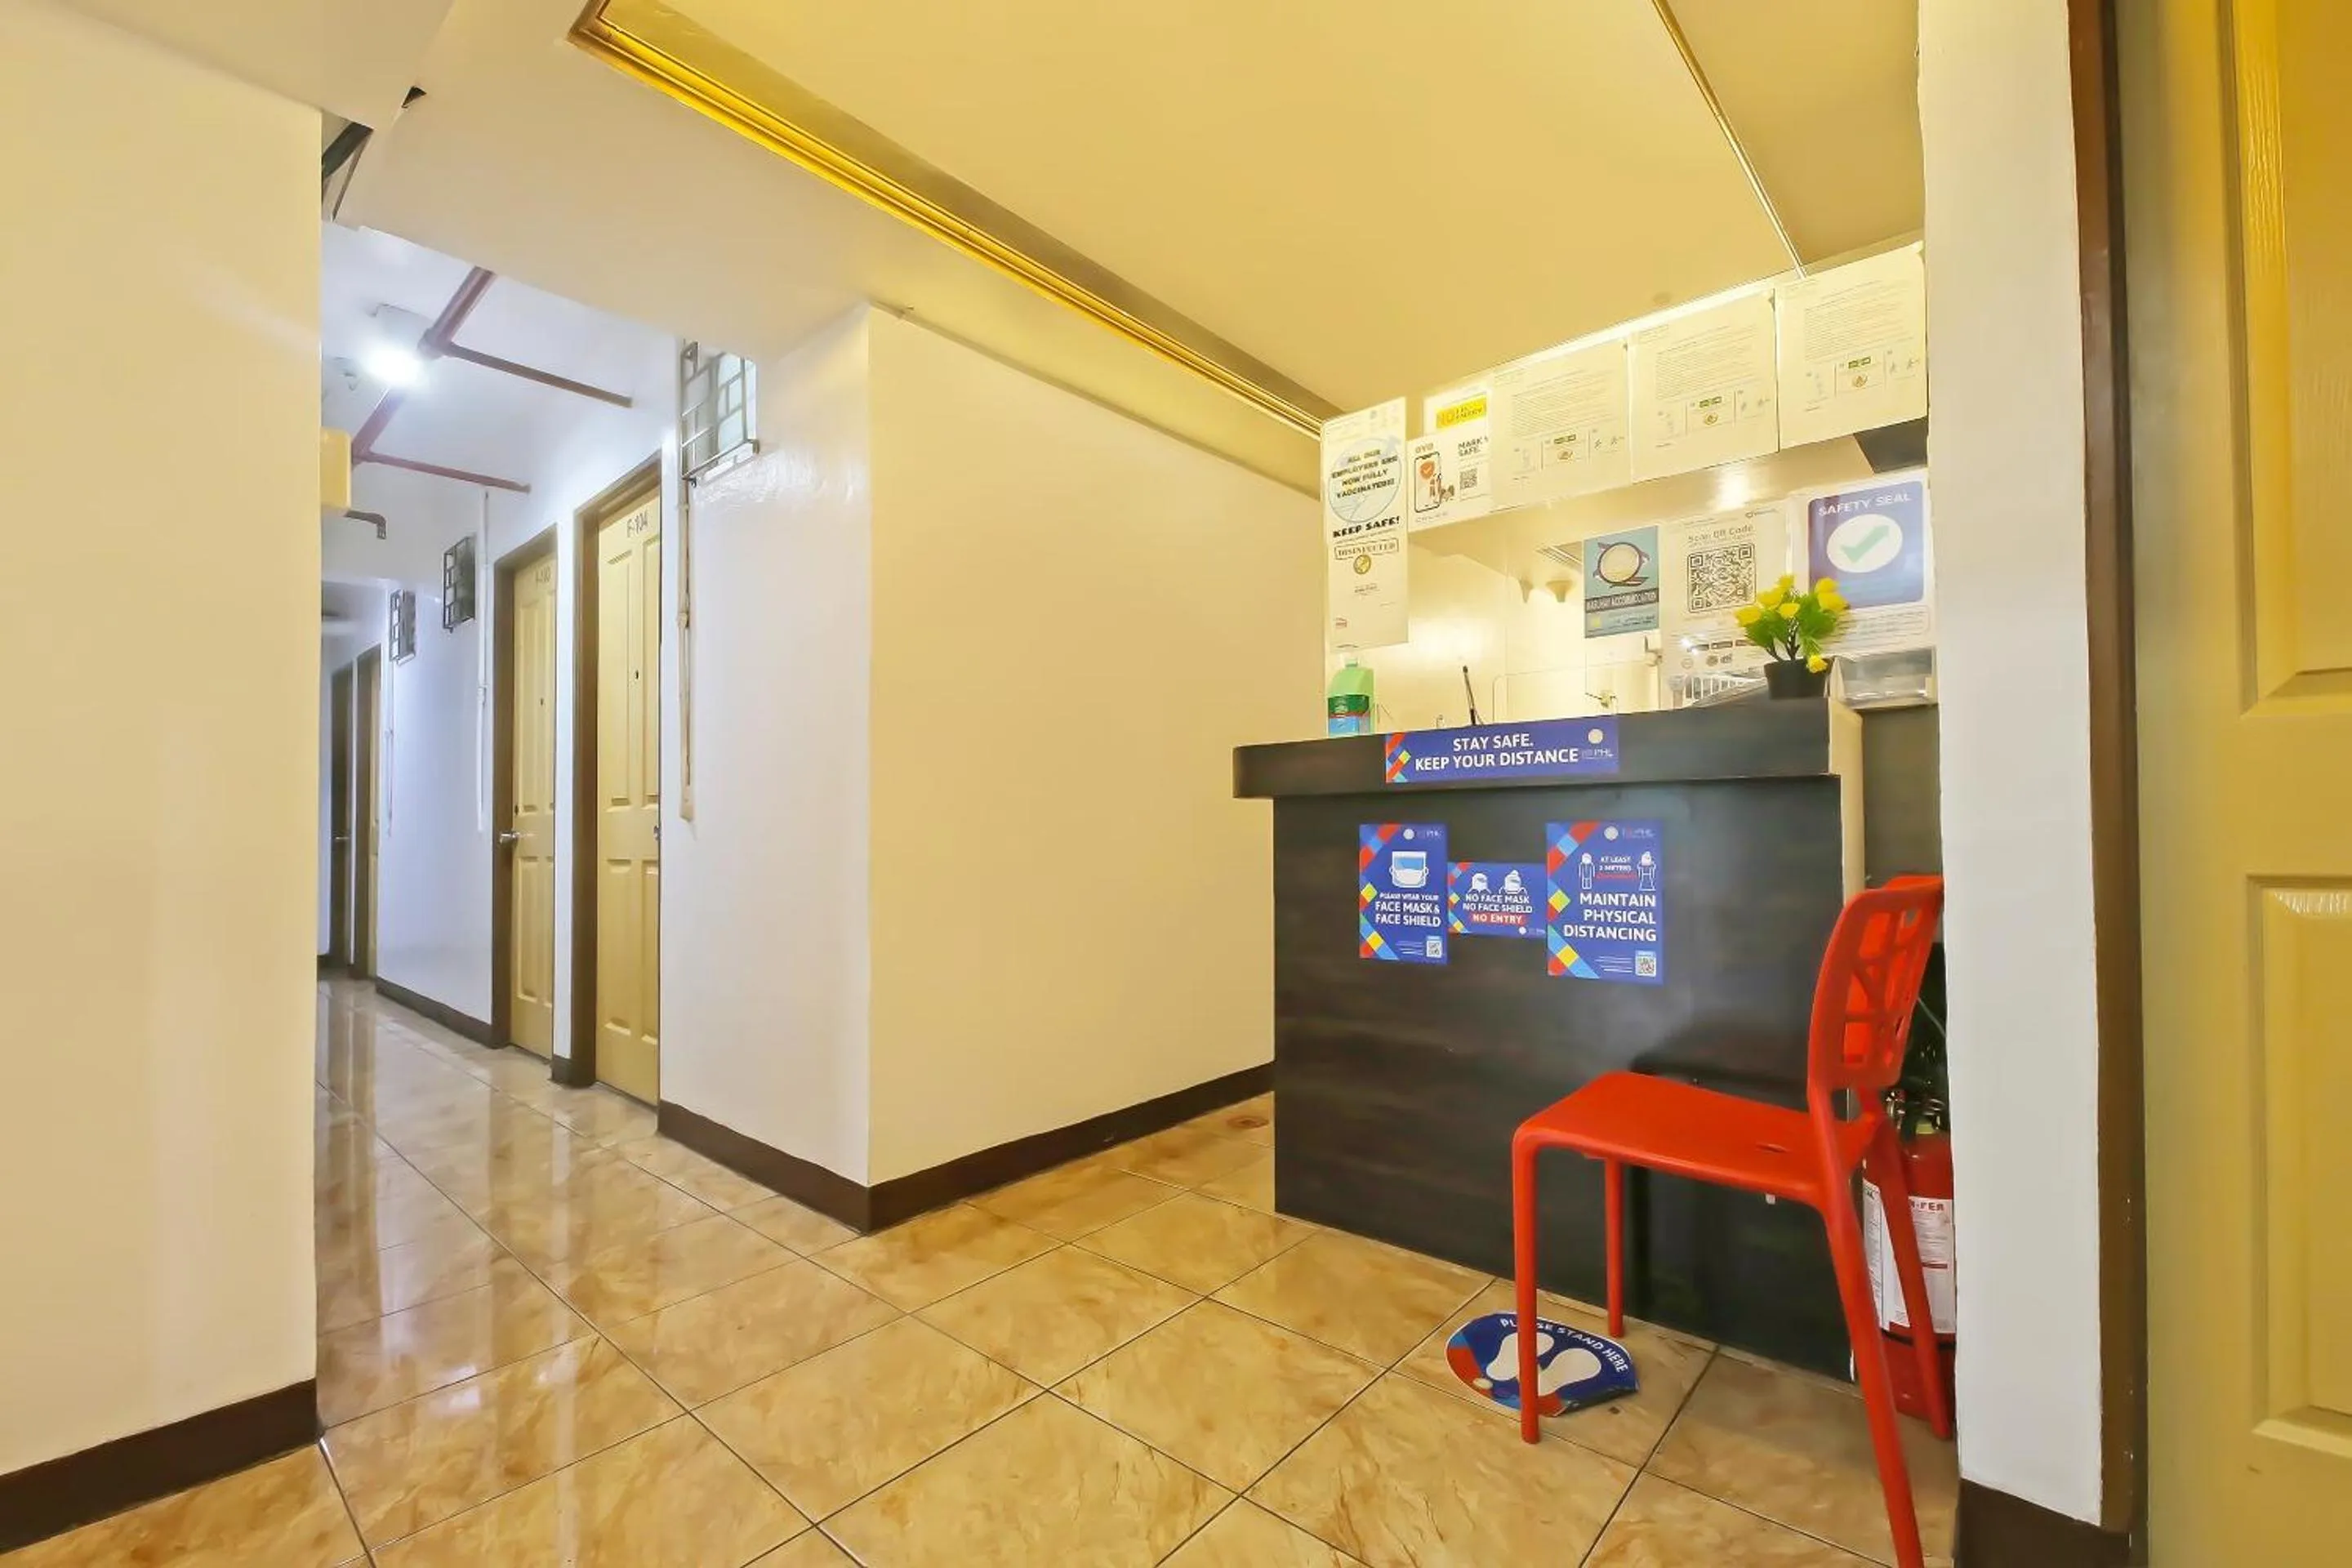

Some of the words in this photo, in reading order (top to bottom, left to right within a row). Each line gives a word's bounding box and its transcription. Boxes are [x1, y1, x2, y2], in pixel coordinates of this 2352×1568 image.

[1458, 438, 1481, 449] MARK
[1342, 475, 1361, 487] NOW
[1362, 468, 1388, 482] FULLY
[1818, 498, 1871, 516] SAFETY
[1877, 492, 1912, 506] SEAL
[1333, 524, 1363, 538] KEEP
[1365, 516, 1401, 532] SAFE!
[1729, 524, 1753, 536] Code
[1338, 542, 1396, 557] DISINFECTED
[1453, 736, 1490, 752] STAY
[1493, 733, 1534, 749] SAFE.
[1415, 756, 1450, 771] KEEP
[1454, 753, 1495, 769] YOUR
[1500, 748, 1579, 766] DISTANCE
[1465, 893, 1480, 902] NO
[1481, 894, 1503, 903] FACE
[1505, 895, 1530, 904] MASK
[1579, 893, 1656, 907] MAINTAIN
[1374, 901, 1401, 913] FACE
[1403, 902, 1432, 915] MASK
[1463, 902, 1477, 911] NO
[1478, 903, 1500, 912] FACE
[1502, 904, 1533, 914] SHIELD
[1374, 914, 1401, 925] FACE
[1403, 915, 1442, 928] SHIELD
[1472, 913, 1487, 922] NO
[1490, 914, 1522, 924] ENTRY
[1584, 909, 1656, 924] PHYSICAL
[1563, 924, 1656, 942] DISTANCING
[1500, 1317, 1552, 1331] PLSE
[1557, 1327, 1604, 1350] STAND
[1602, 1348, 1628, 1372] HERE
